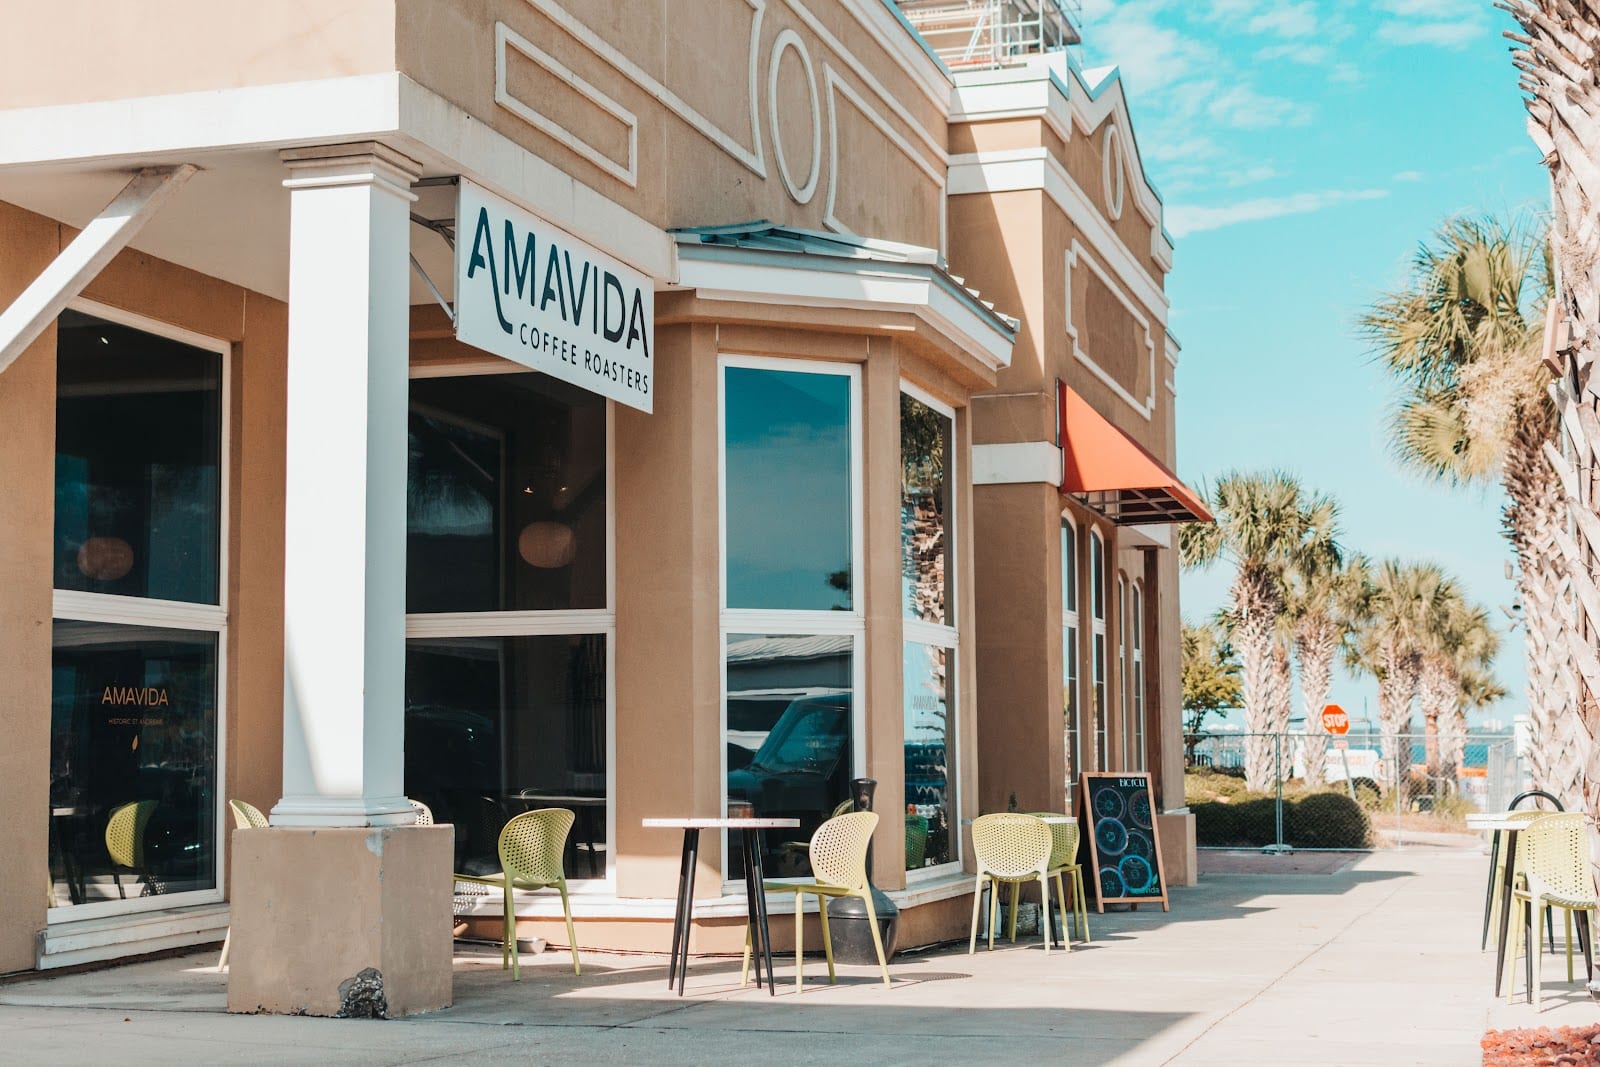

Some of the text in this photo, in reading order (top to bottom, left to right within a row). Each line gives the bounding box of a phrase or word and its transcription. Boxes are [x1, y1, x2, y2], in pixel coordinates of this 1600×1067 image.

[468, 207, 649, 358] AMAVIDA
[520, 323, 648, 394] COFFEE ROASTERS
[101, 686, 169, 706] AMAVIDA
[1323, 713, 1348, 728] STOP
